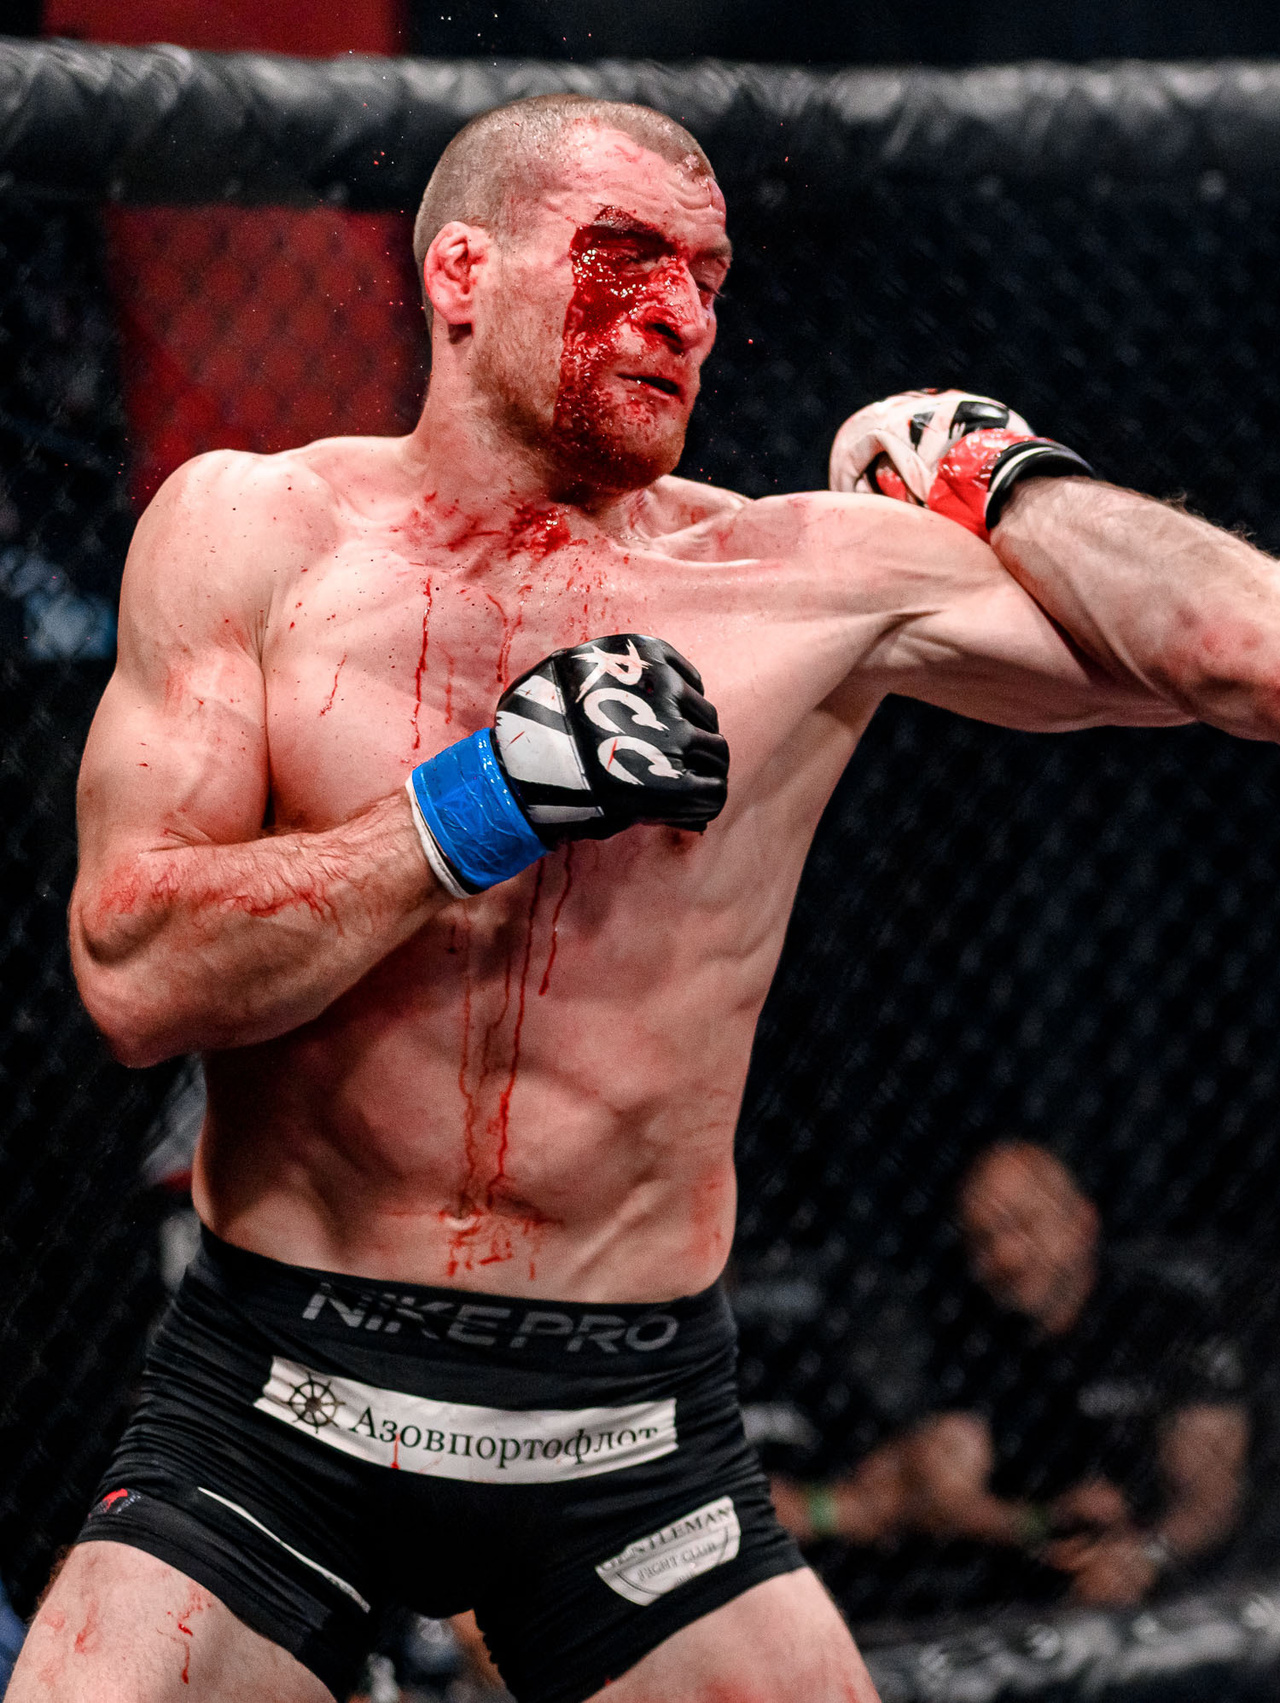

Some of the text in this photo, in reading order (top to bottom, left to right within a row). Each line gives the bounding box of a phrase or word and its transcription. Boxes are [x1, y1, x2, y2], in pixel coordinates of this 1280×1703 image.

[571, 638, 684, 786] RCC
[302, 1281, 680, 1354] NIKE PRO
